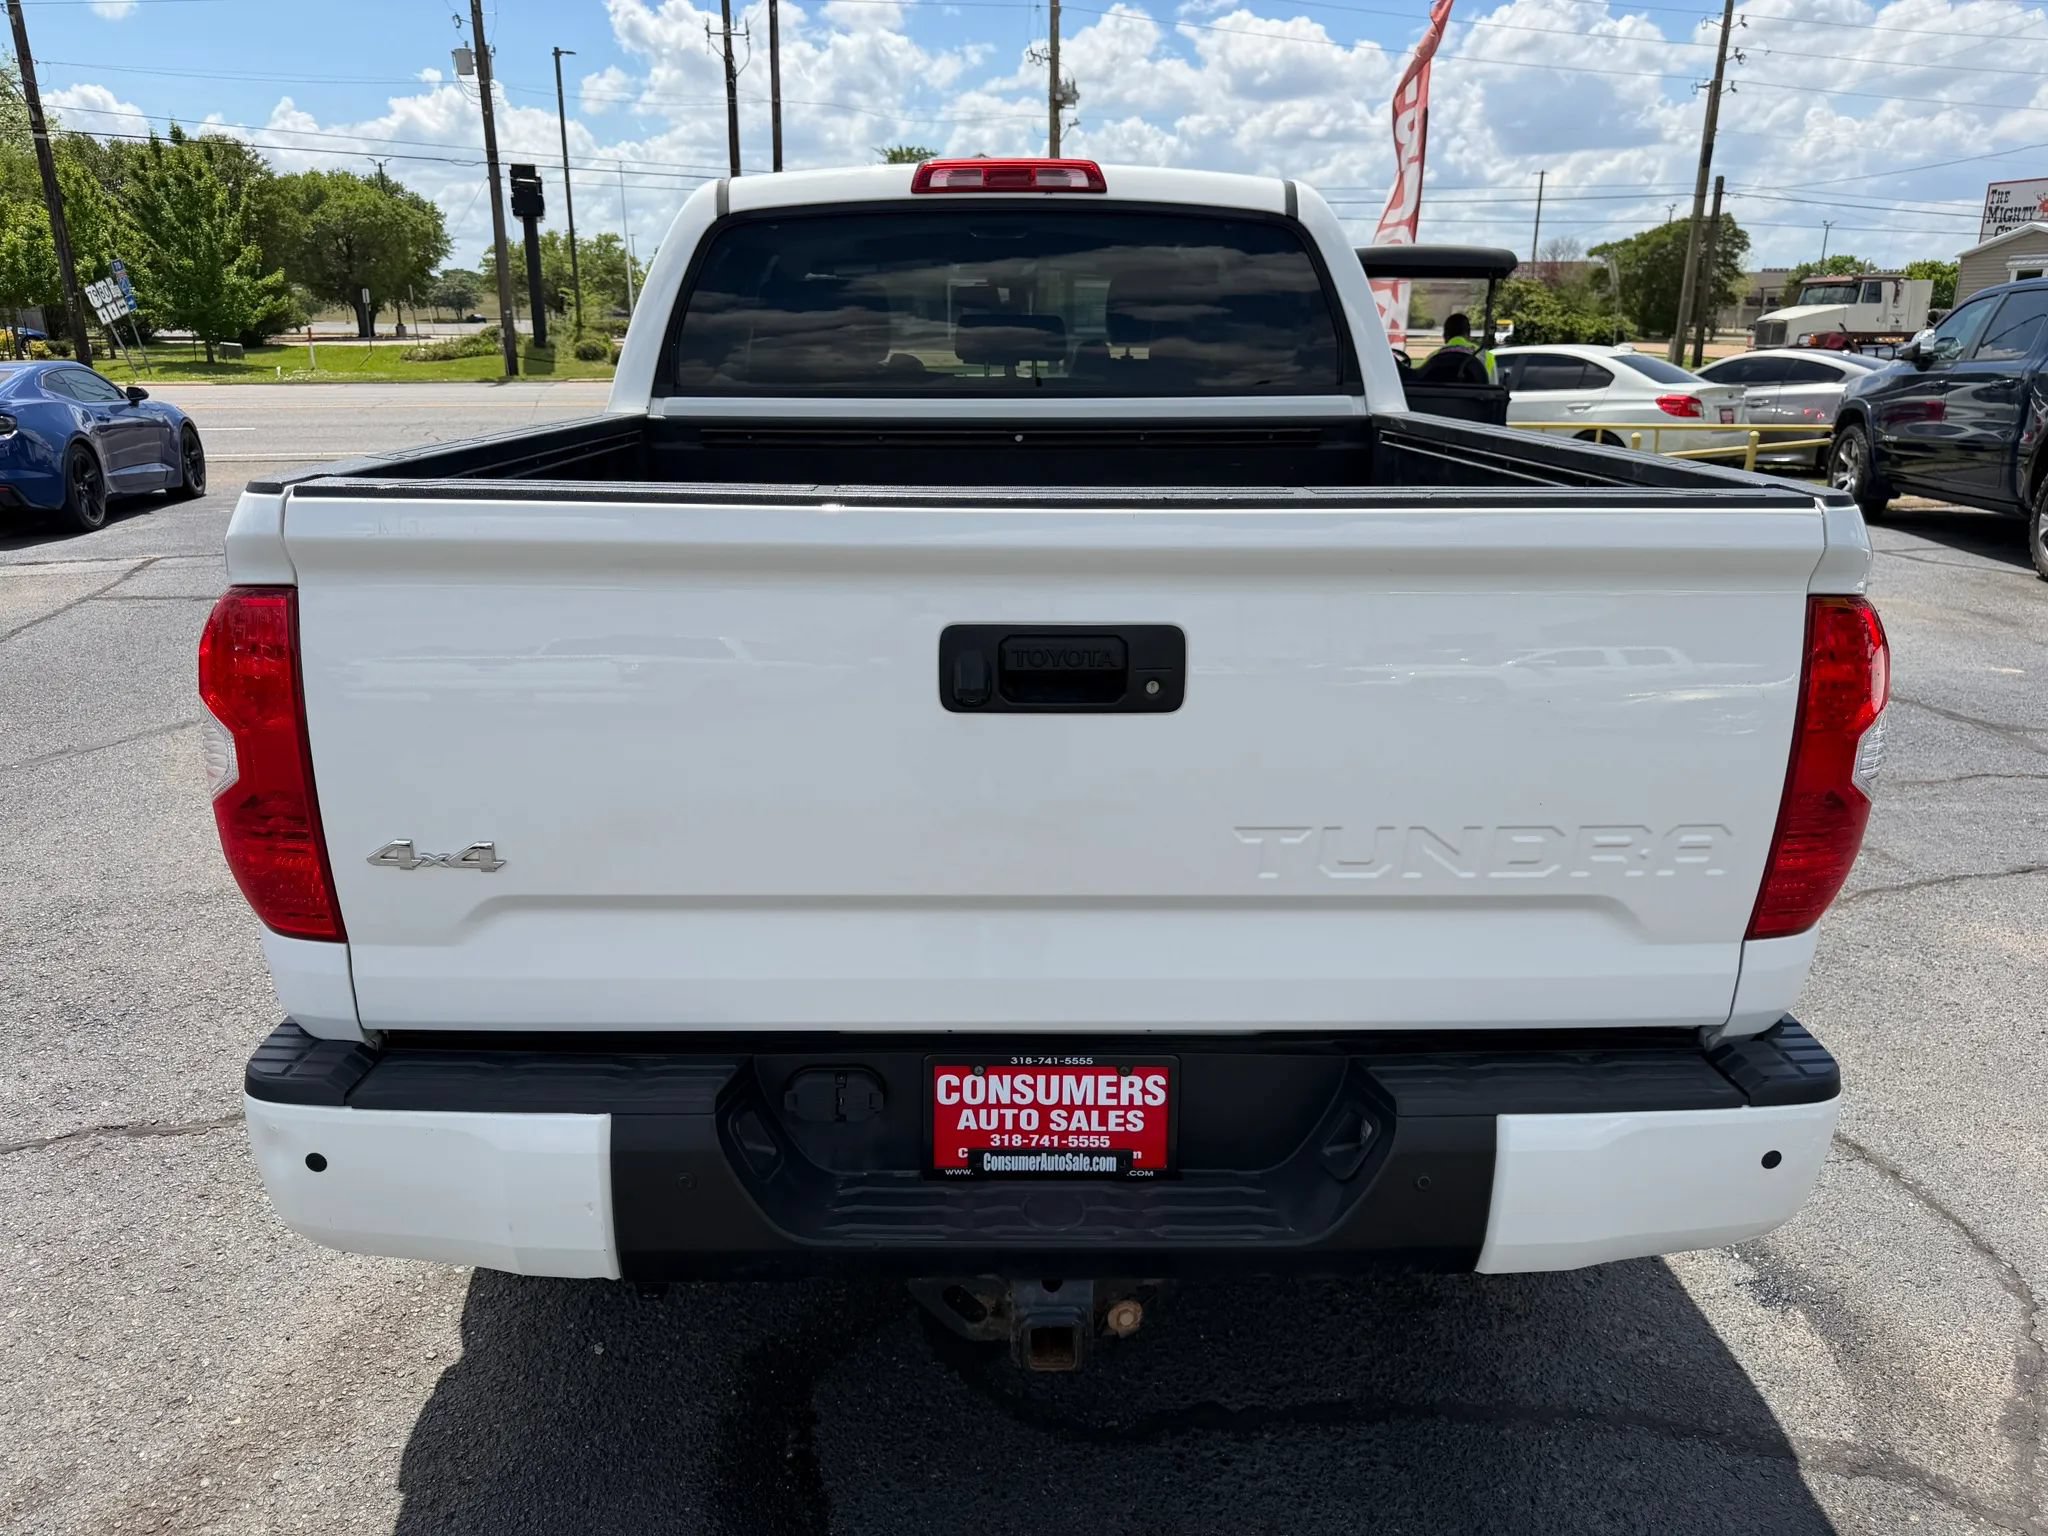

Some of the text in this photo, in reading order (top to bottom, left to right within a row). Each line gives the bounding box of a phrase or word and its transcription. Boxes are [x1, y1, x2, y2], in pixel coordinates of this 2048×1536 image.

[1990, 189, 2011, 204] THE
[1986, 205, 2037, 224] MIGHTY
[87, 289, 99, 302] 79
[98, 285, 111, 300] 80
[1012, 649, 1117, 668] TOYOTA
[366, 838, 507, 873] 4x4
[1233, 823, 1733, 879] TUNDRA
[1010, 1057, 1093, 1065] 318-741-5555
[936, 1074, 1167, 1106] CONSUMERS
[957, 1108, 1145, 1132] AUTO SALES
[989, 1134, 1110, 1148] 318-741-5555
[983, 1152, 1117, 1172] ConsumerAutoSale.com
